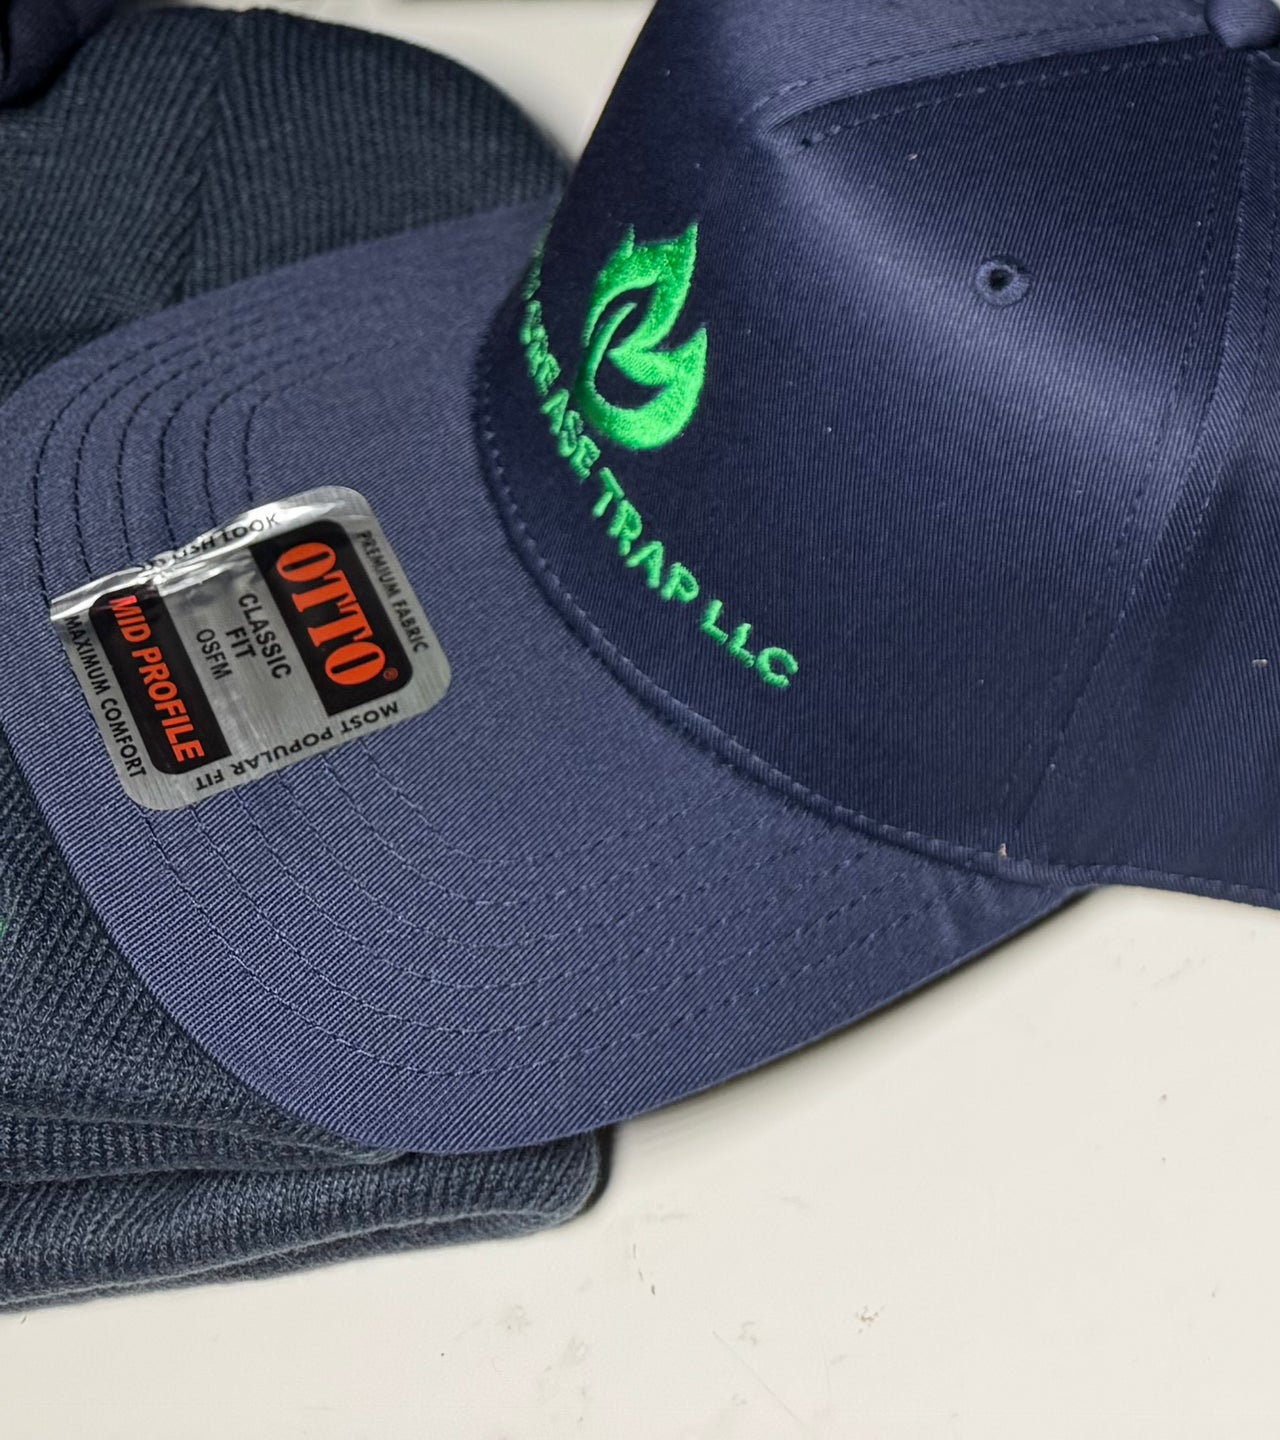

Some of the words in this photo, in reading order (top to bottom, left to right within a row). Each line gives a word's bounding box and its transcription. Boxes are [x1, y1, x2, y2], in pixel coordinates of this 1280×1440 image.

[222, 512, 281, 543] LOOK
[276, 540, 388, 686] OTTO
[354, 529, 399, 599] PREMIUM
[385, 597, 430, 656] FABRIC
[592, 466, 700, 604] TRAP
[700, 599, 800, 690] LLC
[195, 627, 234, 682] OSFM
[224, 626, 256, 661] FIT
[237, 592, 293, 680] CLASSIC
[63, 615, 112, 696] MAXIMUM
[99, 697, 146, 779] COMFORT
[108, 594, 152, 644] MID
[130, 645, 206, 764] PROFILE
[232, 726, 333, 778] POPULAR
[340, 699, 399, 737] MOST
[195, 769, 225, 793] FIT
